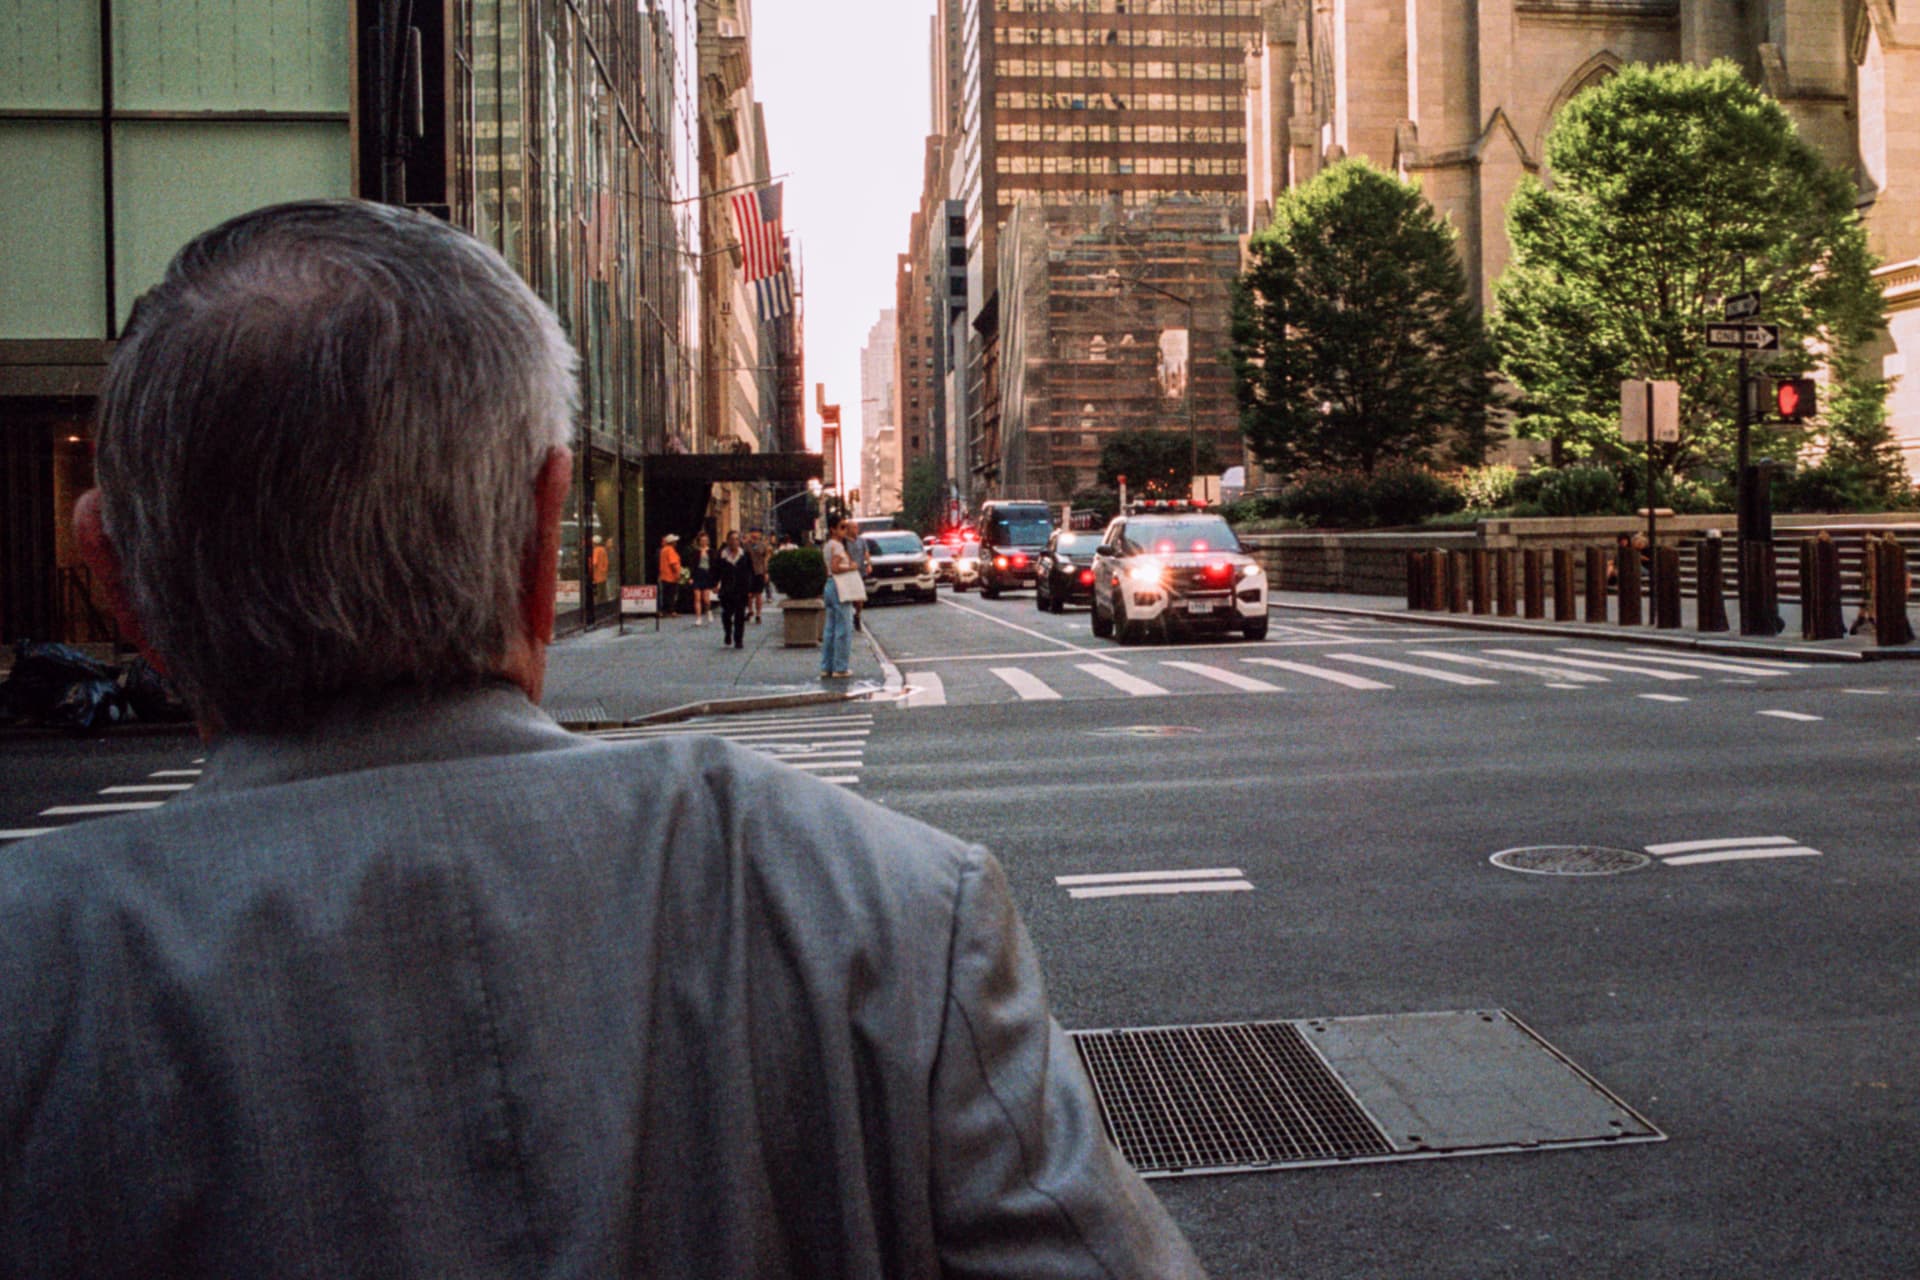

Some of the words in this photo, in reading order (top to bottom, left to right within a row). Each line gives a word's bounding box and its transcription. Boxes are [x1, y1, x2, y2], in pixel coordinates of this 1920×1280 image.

[1715, 330, 1737, 342] ONE
[1745, 332, 1767, 342] WAY
[623, 587, 654, 598] DANGER
